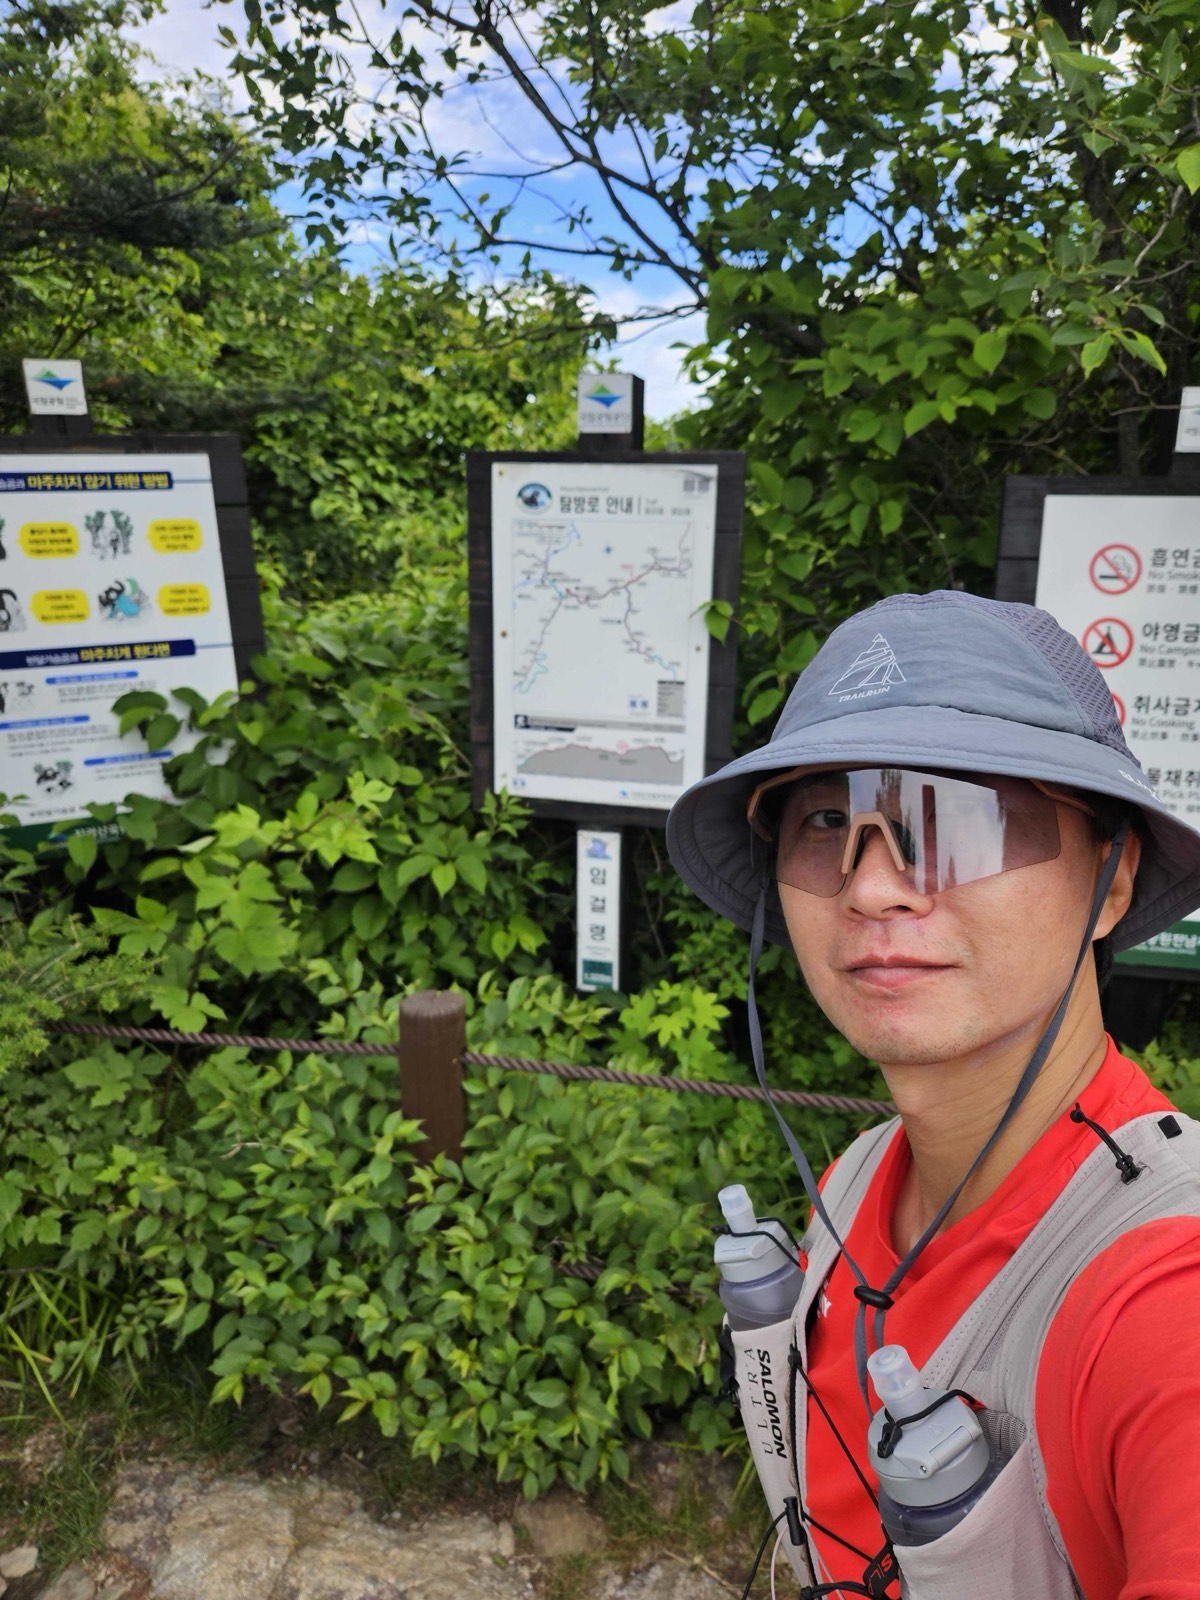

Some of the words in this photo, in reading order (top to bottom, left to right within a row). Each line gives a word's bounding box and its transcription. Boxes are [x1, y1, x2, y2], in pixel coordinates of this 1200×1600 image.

[27, 473, 82, 490] 마주치지
[84, 473, 111, 489] 않기
[114, 473, 140, 488] 위한
[560, 496, 599, 514] 탐방로
[606, 496, 633, 515] 안내
[80, 644, 131, 662] 마주치게
[839, 686, 890, 702] TRAILRUN
[1149, 717, 1195, 731] Cooking
[589, 866, 607, 942] 임걸령
[757, 1348, 787, 1459] SALOMON
